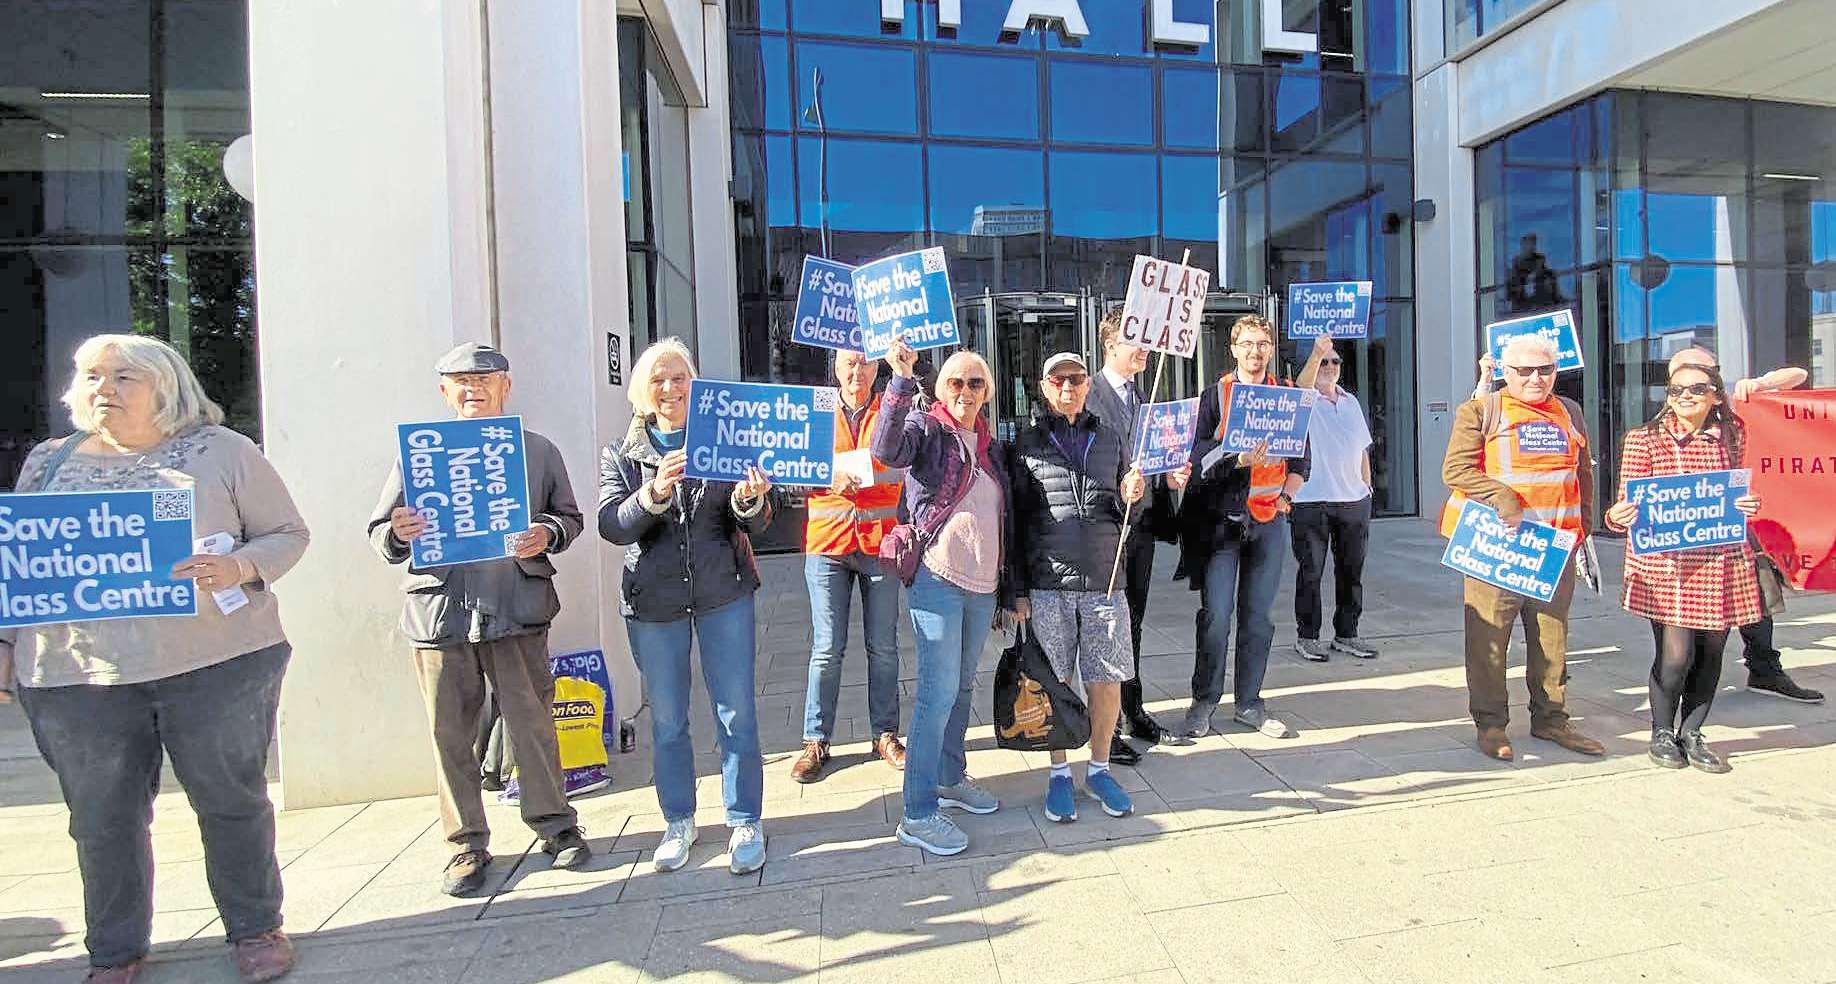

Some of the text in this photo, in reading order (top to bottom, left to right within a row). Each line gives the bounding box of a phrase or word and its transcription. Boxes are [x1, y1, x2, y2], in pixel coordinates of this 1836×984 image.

[882, 0, 1318, 51] LL
[808, 269, 853, 298] #Sav
[892, 263, 921, 291] the
[1142, 261, 1208, 300] GLASS
[820, 295, 857, 322] Nati
[866, 286, 929, 325] National
[1166, 296, 1192, 323] IS
[1294, 286, 1355, 304] #Save the
[1304, 302, 1356, 319] National
[800, 316, 846, 344] Glass
[892, 319, 954, 345] Centre
[1123, 316, 1193, 352] CLASS
[1292, 320, 1365, 335] Glass Centre
[698, 388, 810, 421] #Save the
[1235, 390, 1297, 412] #Save the
[1143, 405, 1191, 430] Save the
[1244, 410, 1296, 432] National
[716, 419, 811, 450] National
[1149, 425, 1190, 450] National
[1265, 431, 1304, 452] Centre
[692, 446, 830, 480] Glass Centre
[1142, 448, 1188, 470] lass Cent
[447, 446, 489, 538] National
[481, 426, 521, 532] #Save the
[1632, 478, 1725, 505] #Save the
[407, 429, 450, 562] Glass Centre
[88, 502, 146, 540] the
[1648, 496, 1726, 525] National
[1464, 508, 1548, 552] #Save the
[1635, 522, 1742, 550] Glass Centre
[2, 538, 153, 581] National
[1470, 532, 1546, 572] National
[1450, 544, 1552, 596] Glass Centre
[0, 582, 68, 618] lass
[74, 578, 190, 612] Centre
